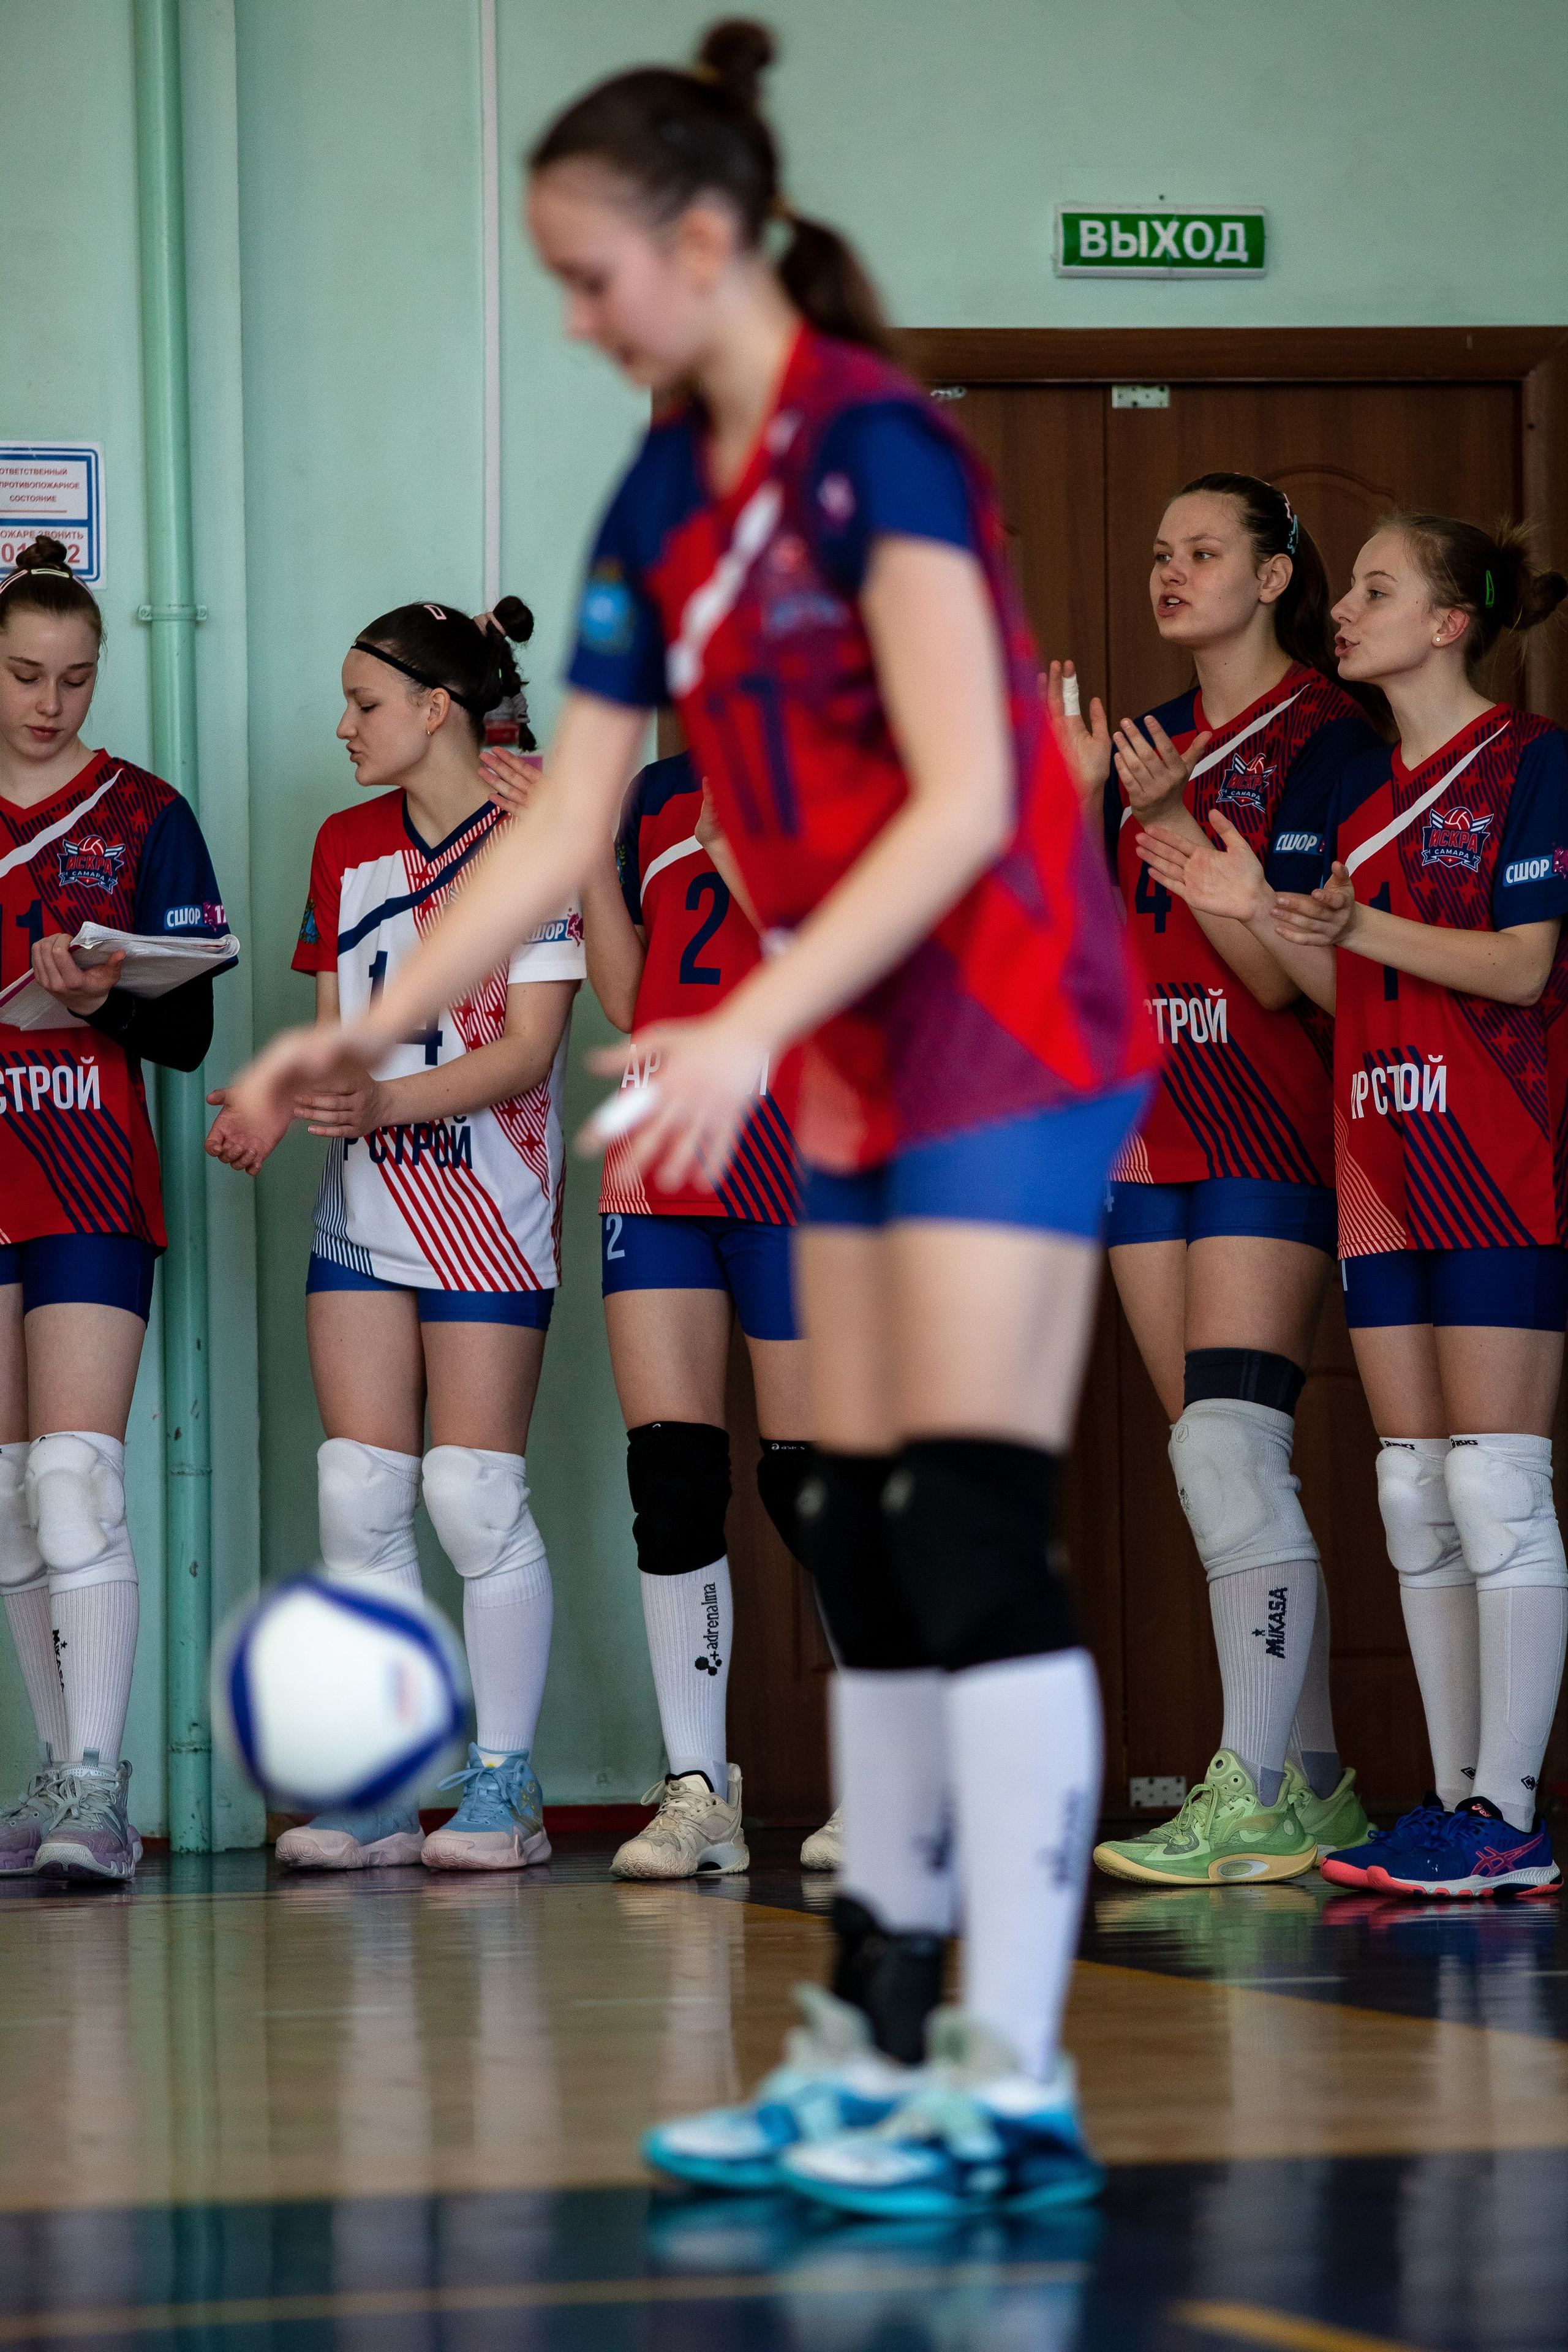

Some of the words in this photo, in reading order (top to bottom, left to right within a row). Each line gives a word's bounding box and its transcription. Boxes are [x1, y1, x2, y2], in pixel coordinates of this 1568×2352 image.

[1079, 219, 1249, 263] ВЫХОД
[0, 530, 36, 539] ОЖАРЕ
[1231, 791, 1260, 801] САМАРА
[1276, 834, 1317, 851] СШОР
[1429, 829, 1478, 853] ИСКРА
[1434, 849, 1469, 859] САМАРА
[66, 855, 112, 876] ИСКРА
[72, 870, 105, 881] САМАРА
[1506, 859, 1550, 883] СШОР
[167, 907, 202, 927] СШОР
[529, 922, 564, 941] ШОР
[679, 872, 729, 985] 2
[606, 1213, 625, 1261] 2
[1265, 1587, 1287, 1659] MIKASA
